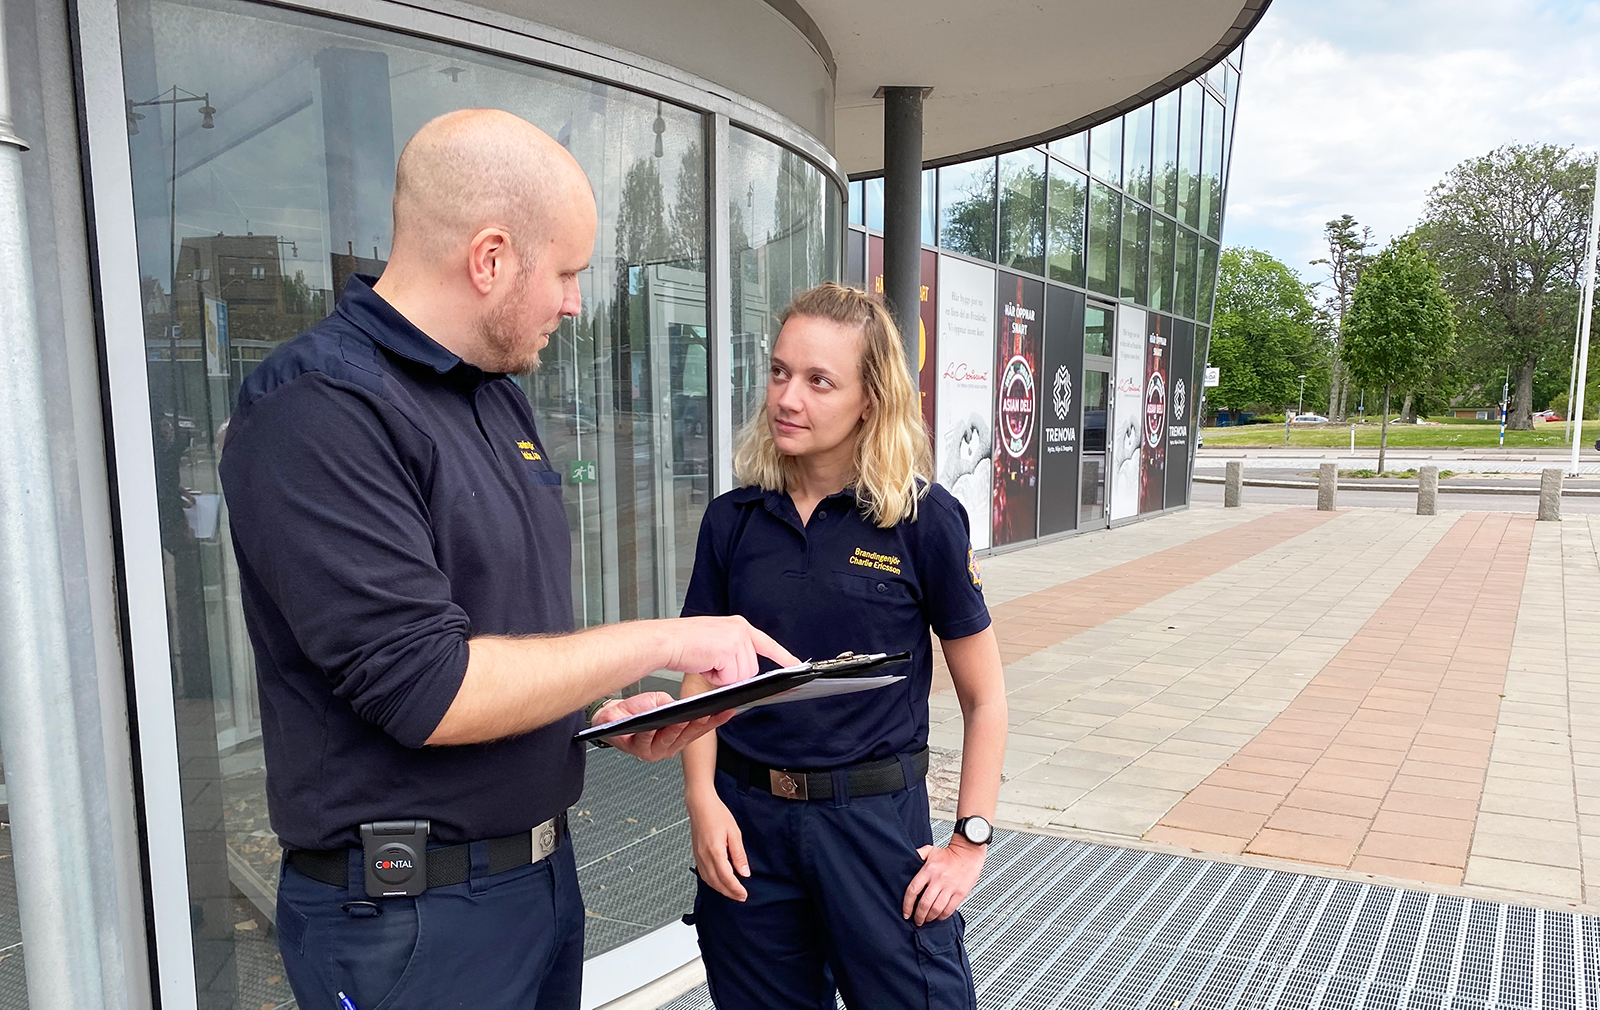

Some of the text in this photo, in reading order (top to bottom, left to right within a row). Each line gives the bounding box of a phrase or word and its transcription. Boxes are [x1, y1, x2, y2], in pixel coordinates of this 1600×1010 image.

[1004, 301, 1036, 322] HÄR ÖPPNAR
[1003, 398, 1032, 412] ASIAN DELI
[1045, 427, 1076, 442] TRENOVA
[849, 555, 901, 575] Charlie Ericsson
[855, 547, 900, 566] Brandingenjör
[375, 860, 412, 869] CONTAL
